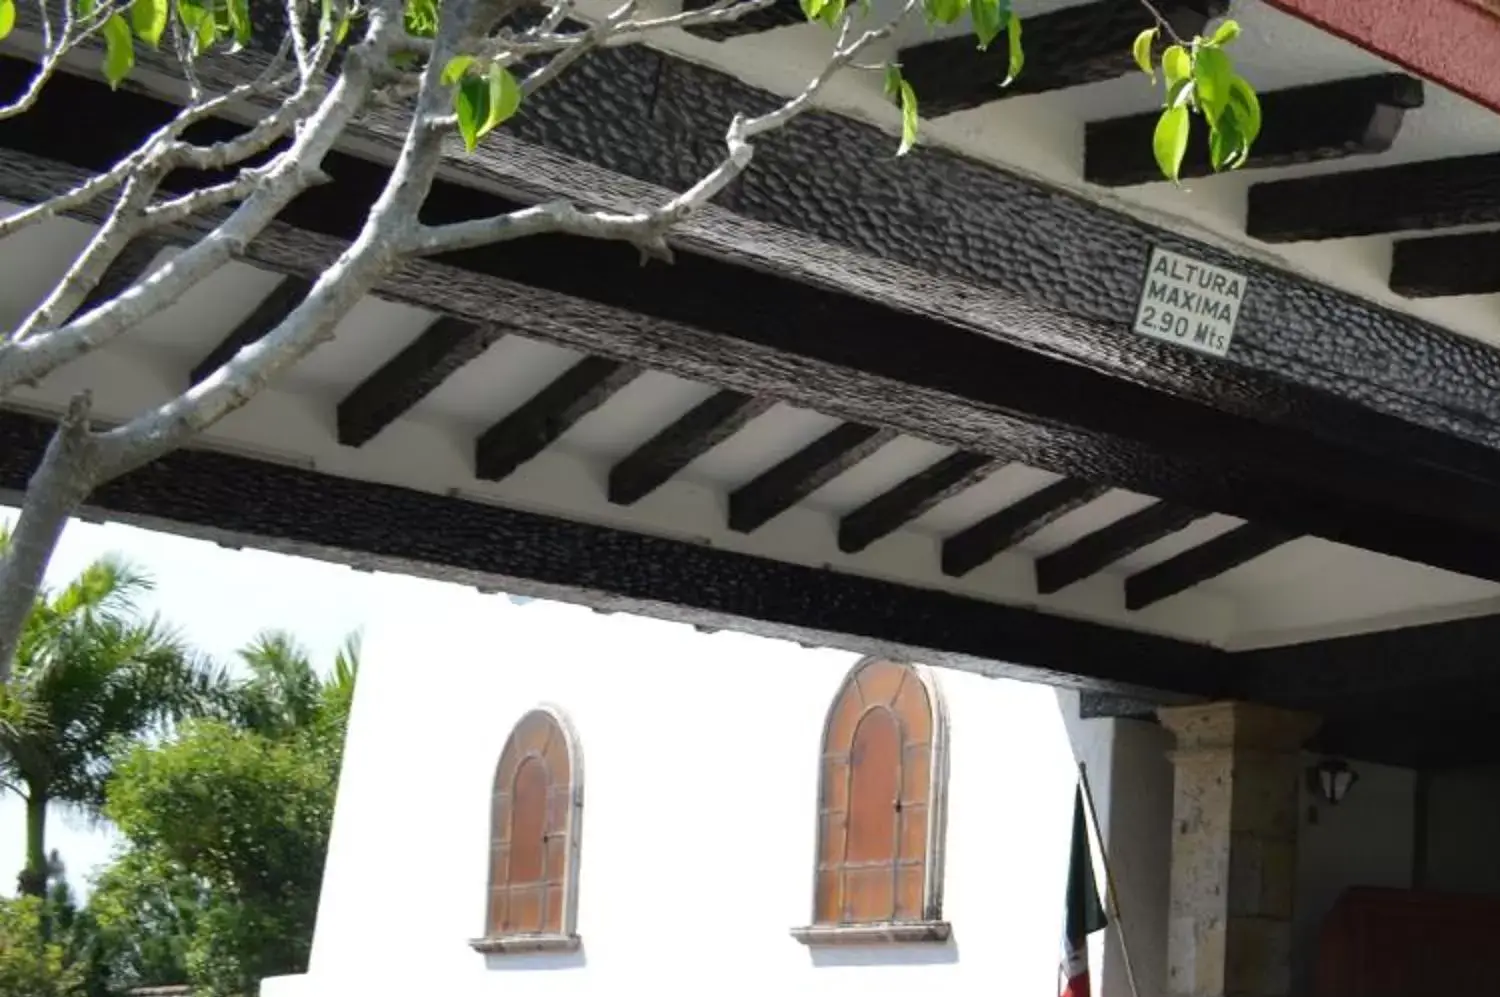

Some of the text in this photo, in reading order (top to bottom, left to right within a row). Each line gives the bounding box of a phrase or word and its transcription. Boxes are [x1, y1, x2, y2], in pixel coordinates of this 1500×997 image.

[1154, 255, 1240, 299] ALTURA
[1141, 305, 1189, 337] 2.90
[1147, 280, 1231, 324] MAXIMA
